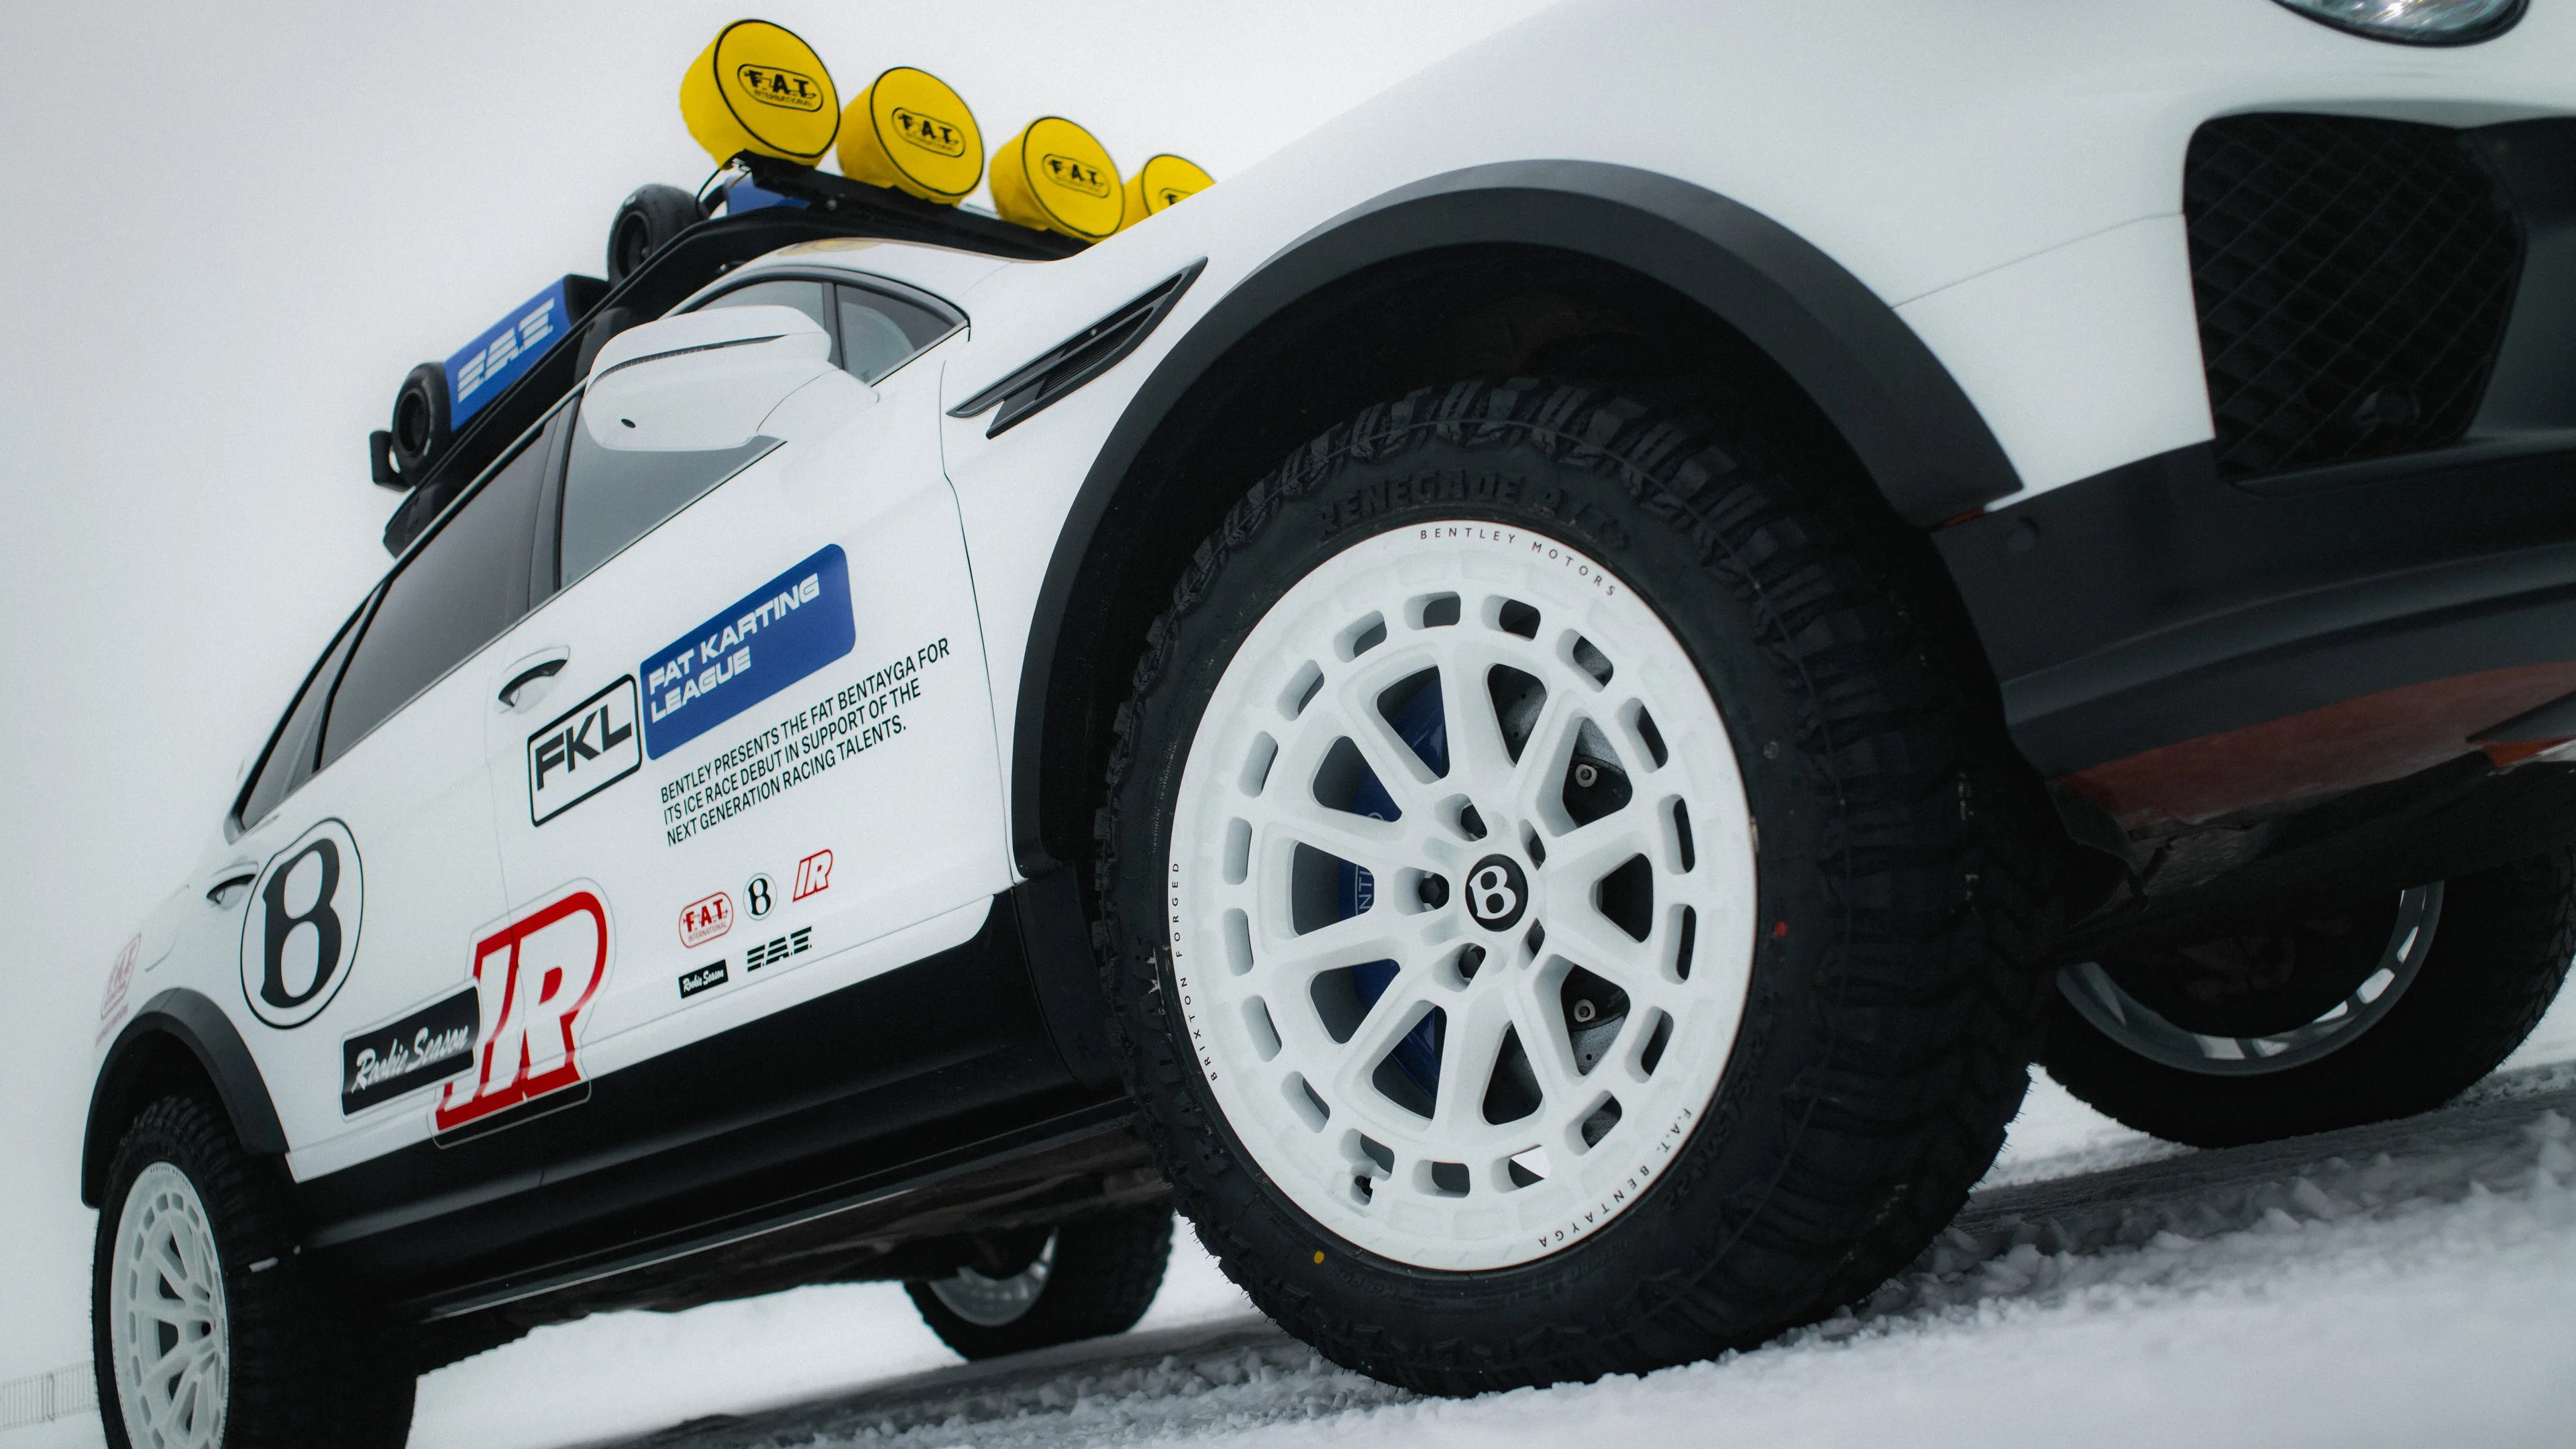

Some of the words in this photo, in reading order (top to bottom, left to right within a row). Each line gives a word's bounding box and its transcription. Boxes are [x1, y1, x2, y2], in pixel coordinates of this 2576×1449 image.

[1420, 527, 1516, 544] BENTLEY
[1532, 541, 1616, 596] MOTORS
[649, 648, 695, 696] FAT
[700, 572, 820, 665] KARTING
[651, 645, 751, 724] LEAGUE
[661, 762, 712, 804] BENTLEY
[714, 727, 780, 775] PRESENTS
[780, 711, 808, 739] THE
[810, 697, 834, 725] FAT
[838, 656, 916, 710] BENTAYGA
[918, 637, 950, 669] FOR
[535, 704, 632, 792] FKL
[664, 803, 682, 825] ITS
[684, 791, 703, 815] ICE
[705, 773, 739, 804] RACE
[740, 749, 782, 786] DEBUT
[784, 741, 800, 763] IN
[802, 706, 865, 753] SUPPORT
[869, 694, 888, 719] OF
[889, 678, 921, 708] THE
[667, 817, 697, 847] NEXT
[700, 776, 780, 830] GENERATION
[782, 749, 836, 790] RACING
[837, 714, 906, 761] TALENTS.
[1172, 863, 1183, 958] FORGED
[351, 1038, 409, 1093] Rookie
[405, 1025, 469, 1073] Season
[1181, 977, 1218, 1081] BRIXTON
[1538, 1165, 1650, 1248] BENTAYGA
